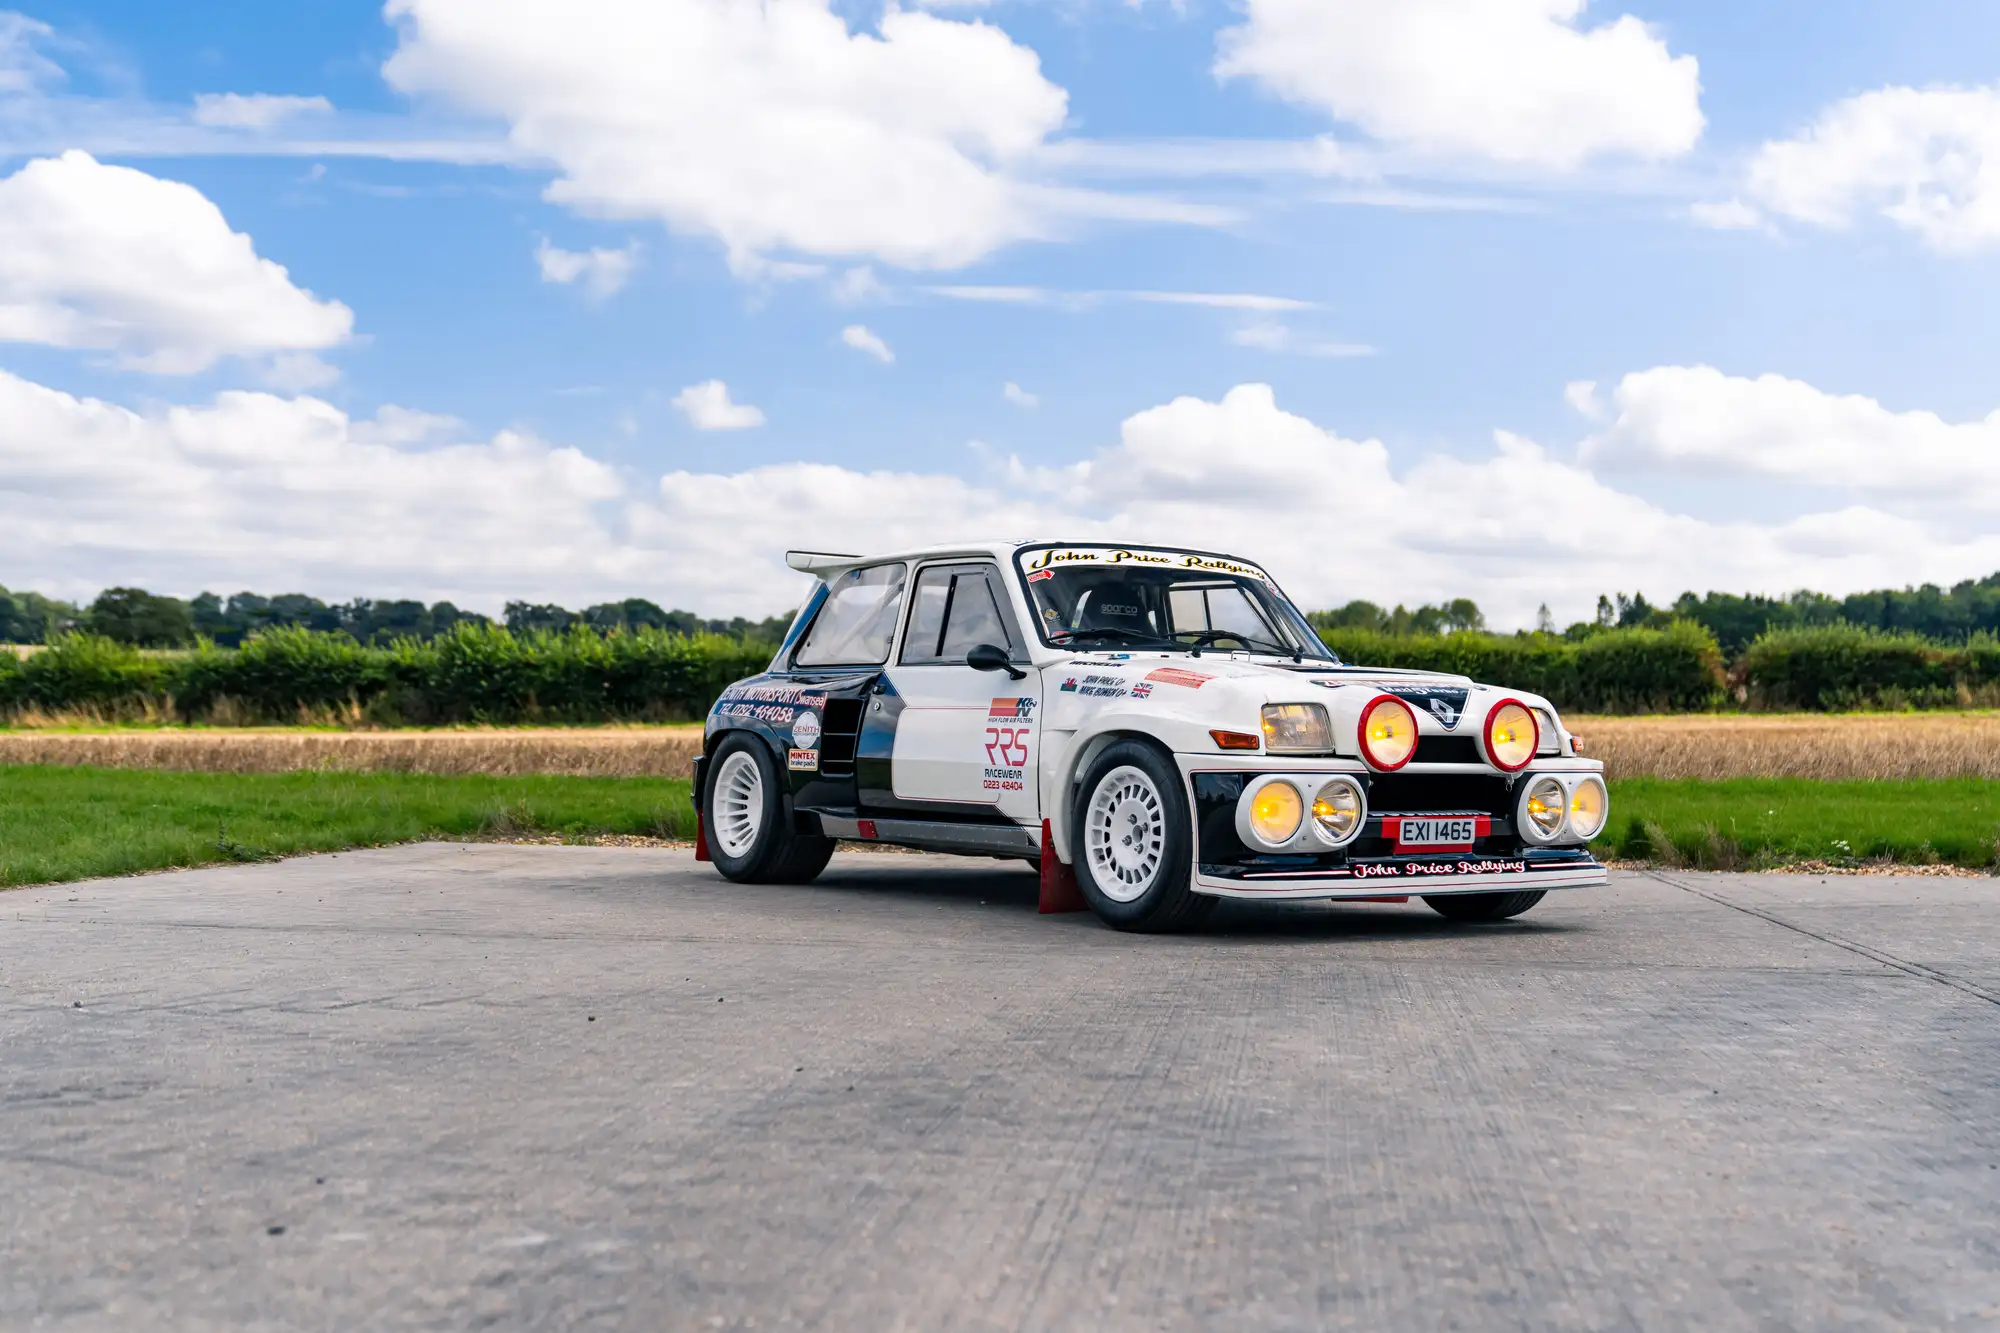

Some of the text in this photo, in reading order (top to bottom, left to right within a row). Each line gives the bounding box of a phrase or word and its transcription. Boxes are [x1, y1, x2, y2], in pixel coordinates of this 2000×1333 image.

[1030, 549, 1265, 580] John Price Rallying
[1101, 603, 1138, 615] sparco
[793, 725, 820, 733] ZENITH
[790, 752, 815, 760] MINTEX
[984, 768, 1023, 779] RACEWEAR
[983, 780, 1023, 791] 0223 42404
[1403, 821, 1472, 841] EXI 1465
[1354, 859, 1526, 878] John Price Rallying
